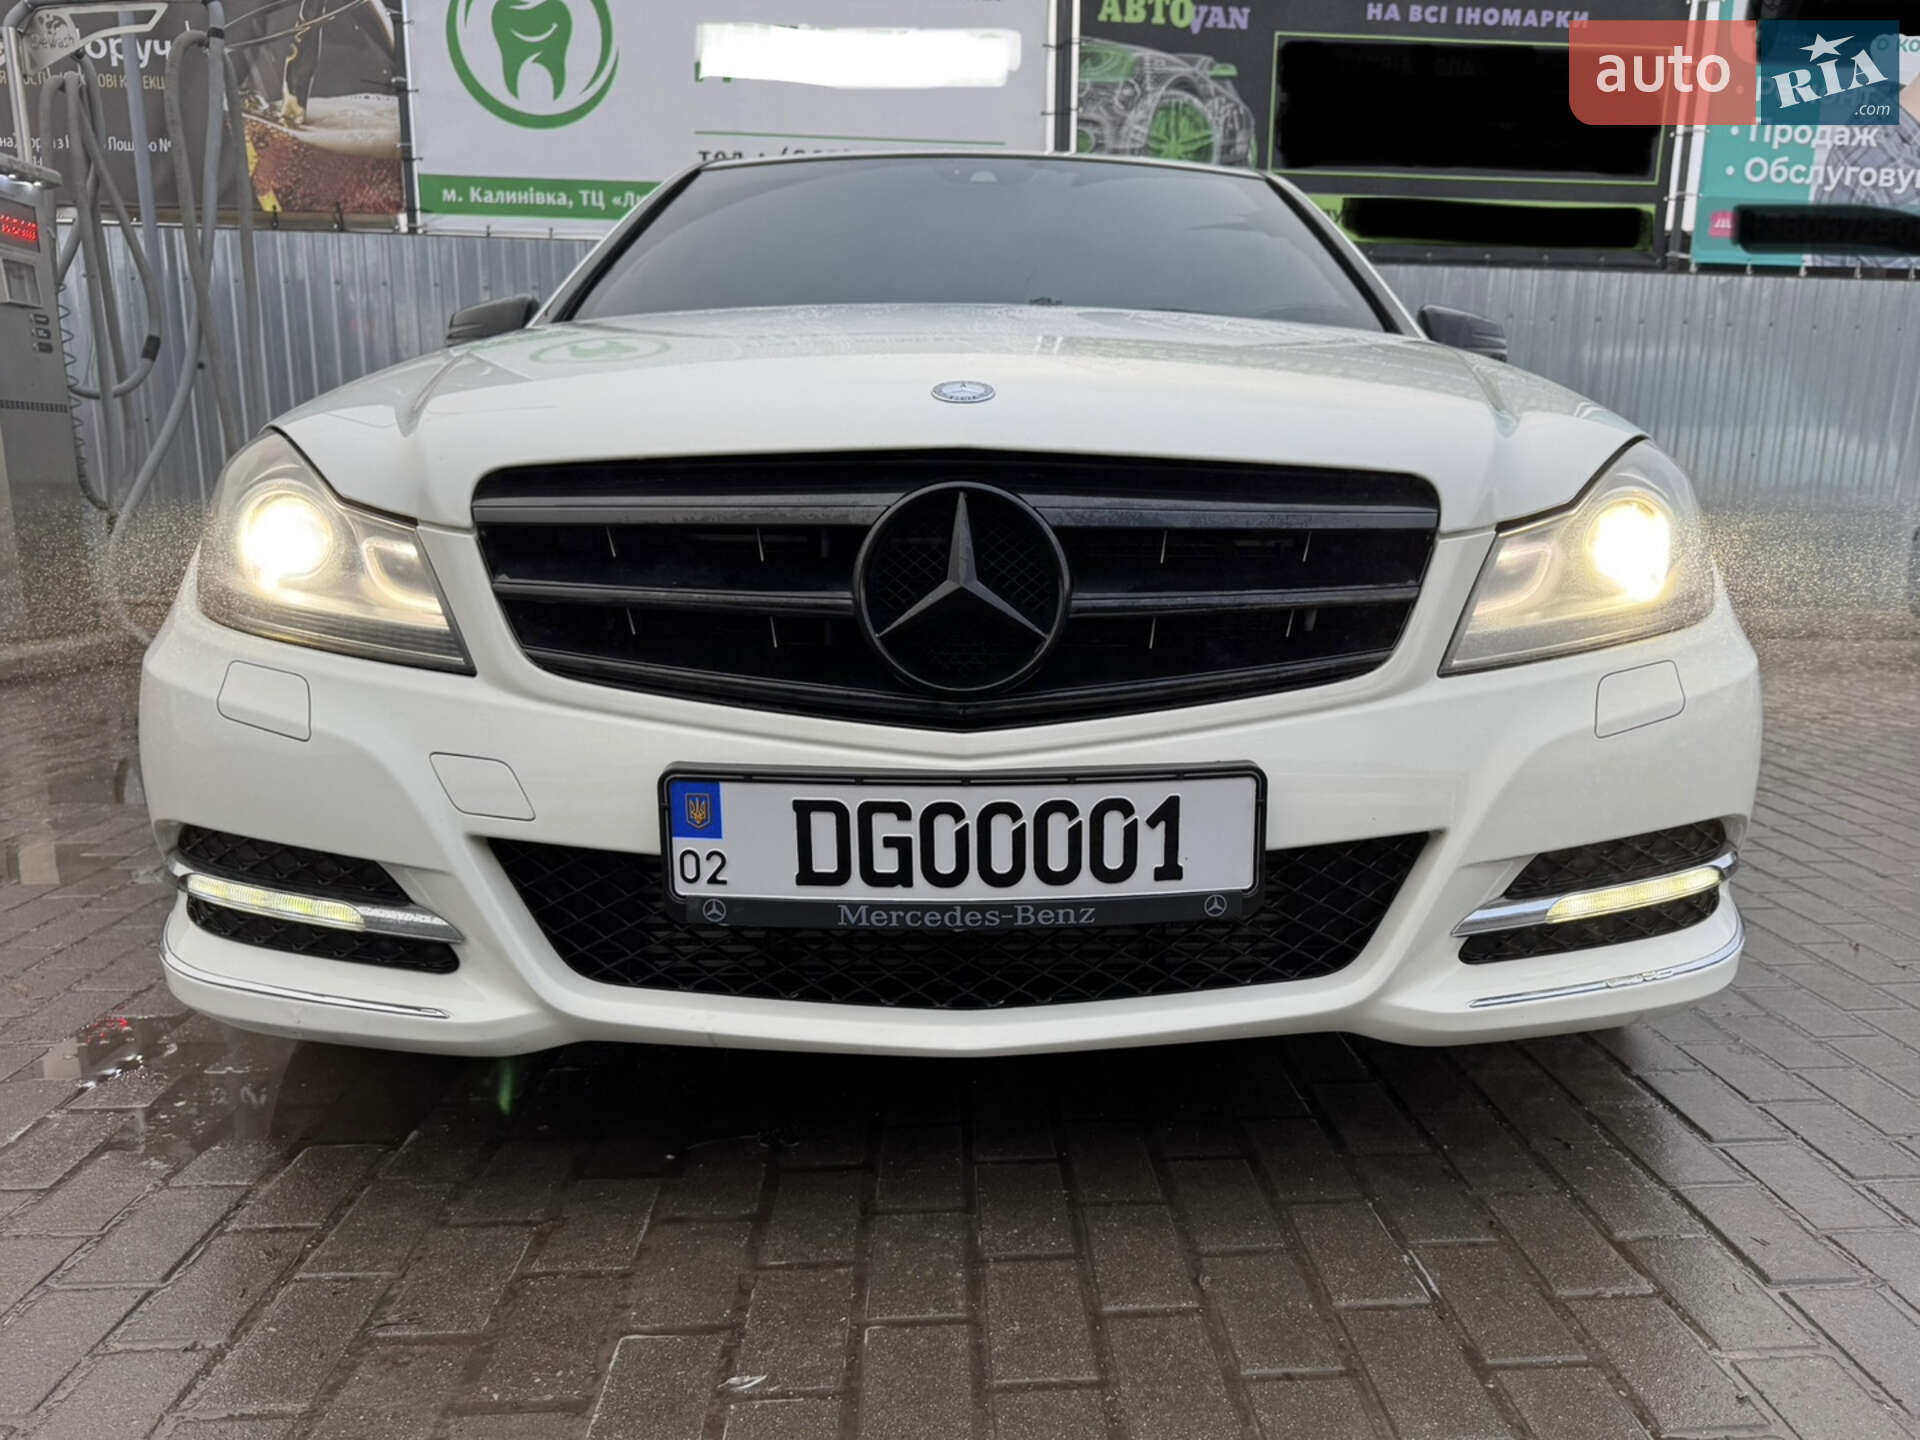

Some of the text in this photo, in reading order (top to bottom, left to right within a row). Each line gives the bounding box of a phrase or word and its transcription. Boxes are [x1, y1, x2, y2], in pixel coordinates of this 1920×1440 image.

[1366, 3, 1589, 28] НА ВСІ ІНОМАРКИ
[441, 188, 463, 202] м.
[469, 186, 574, 209] Калинівка,
[578, 189, 606, 210] ТЦ
[792, 795, 1184, 888] DG00001
[679, 848, 728, 885] 02
[836, 903, 1097, 928] Mercedes-Benz
